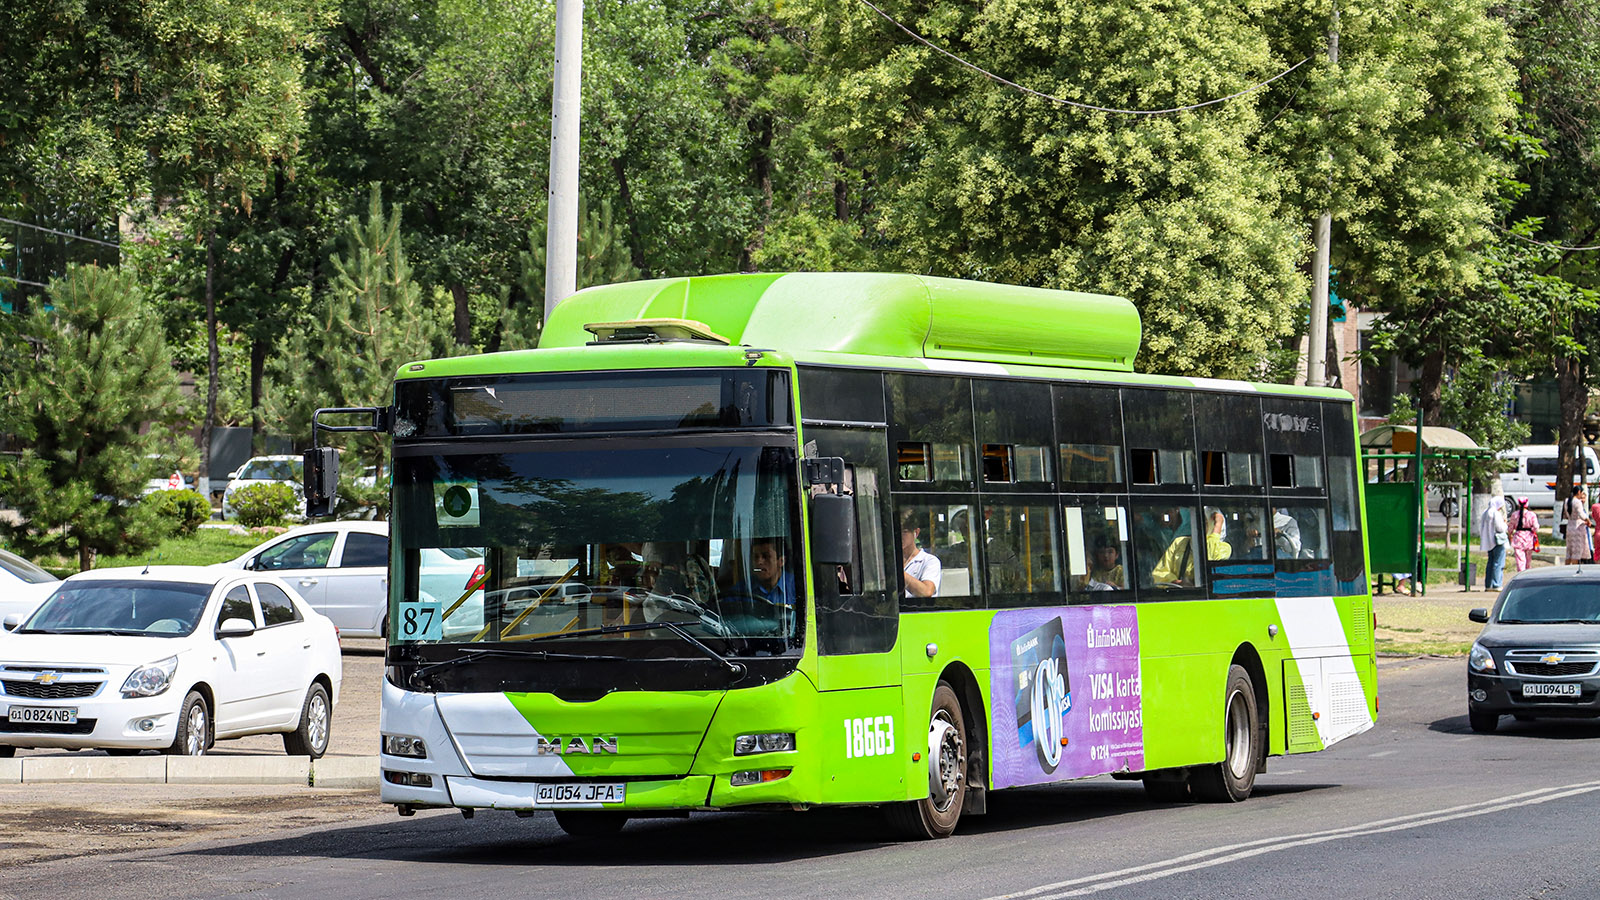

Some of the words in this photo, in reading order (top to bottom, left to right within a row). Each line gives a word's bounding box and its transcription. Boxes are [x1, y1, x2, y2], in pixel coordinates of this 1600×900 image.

[403, 607, 435, 635] 87
[1095, 627, 1132, 648] InfinBANK
[1088, 673, 1114, 700] VISA
[1116, 672, 1141, 697] karta
[1525, 686, 1534, 694] 01
[11, 710, 22, 720] 01
[1089, 703, 1143, 735] komissiyasi
[537, 736, 619, 755] MAN
[844, 715, 895, 759] 18663
[1096, 744, 1110, 760] 1214
[539, 787, 553, 800] 01
[556, 785, 581, 800] 054
[586, 785, 614, 800] JFA
